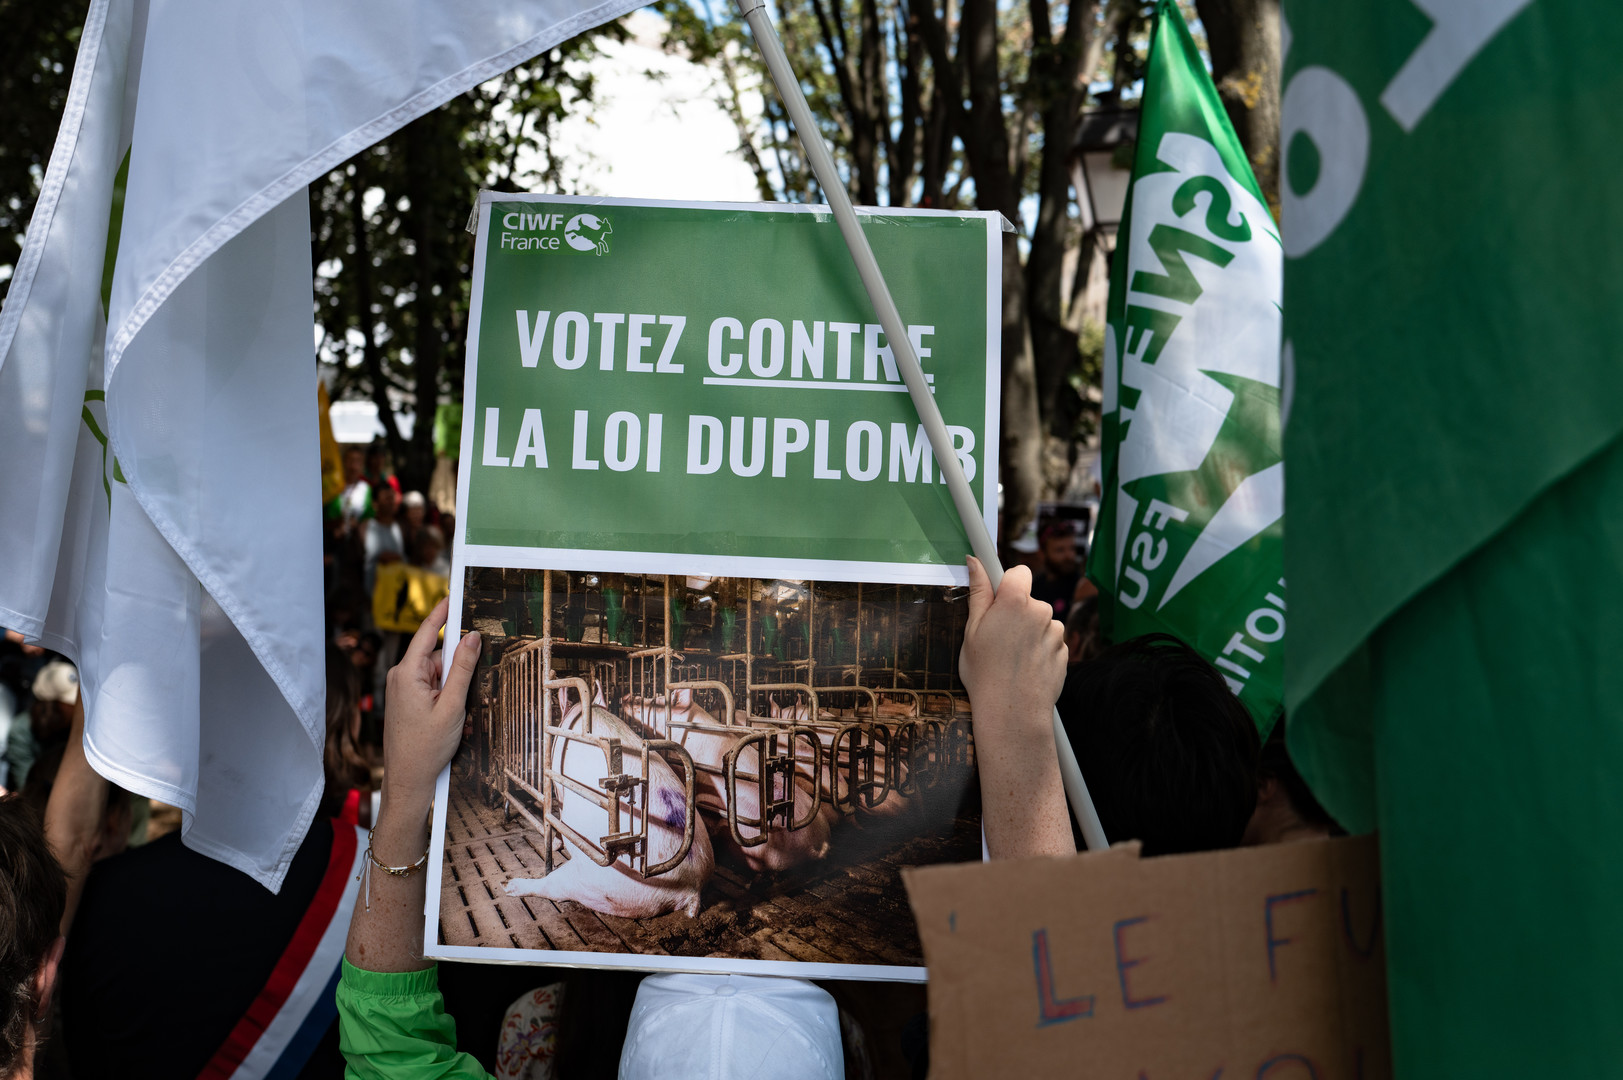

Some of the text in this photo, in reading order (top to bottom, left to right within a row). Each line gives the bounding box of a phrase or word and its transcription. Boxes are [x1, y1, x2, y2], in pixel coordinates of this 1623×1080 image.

[500, 232, 561, 250] France
[502, 212, 564, 231] CIWF
[515, 310, 935, 384] VOTEZ CONTRE
[481, 407, 977, 485] LA LOI DUPLOMB
[1031, 915, 1171, 1029] LE
